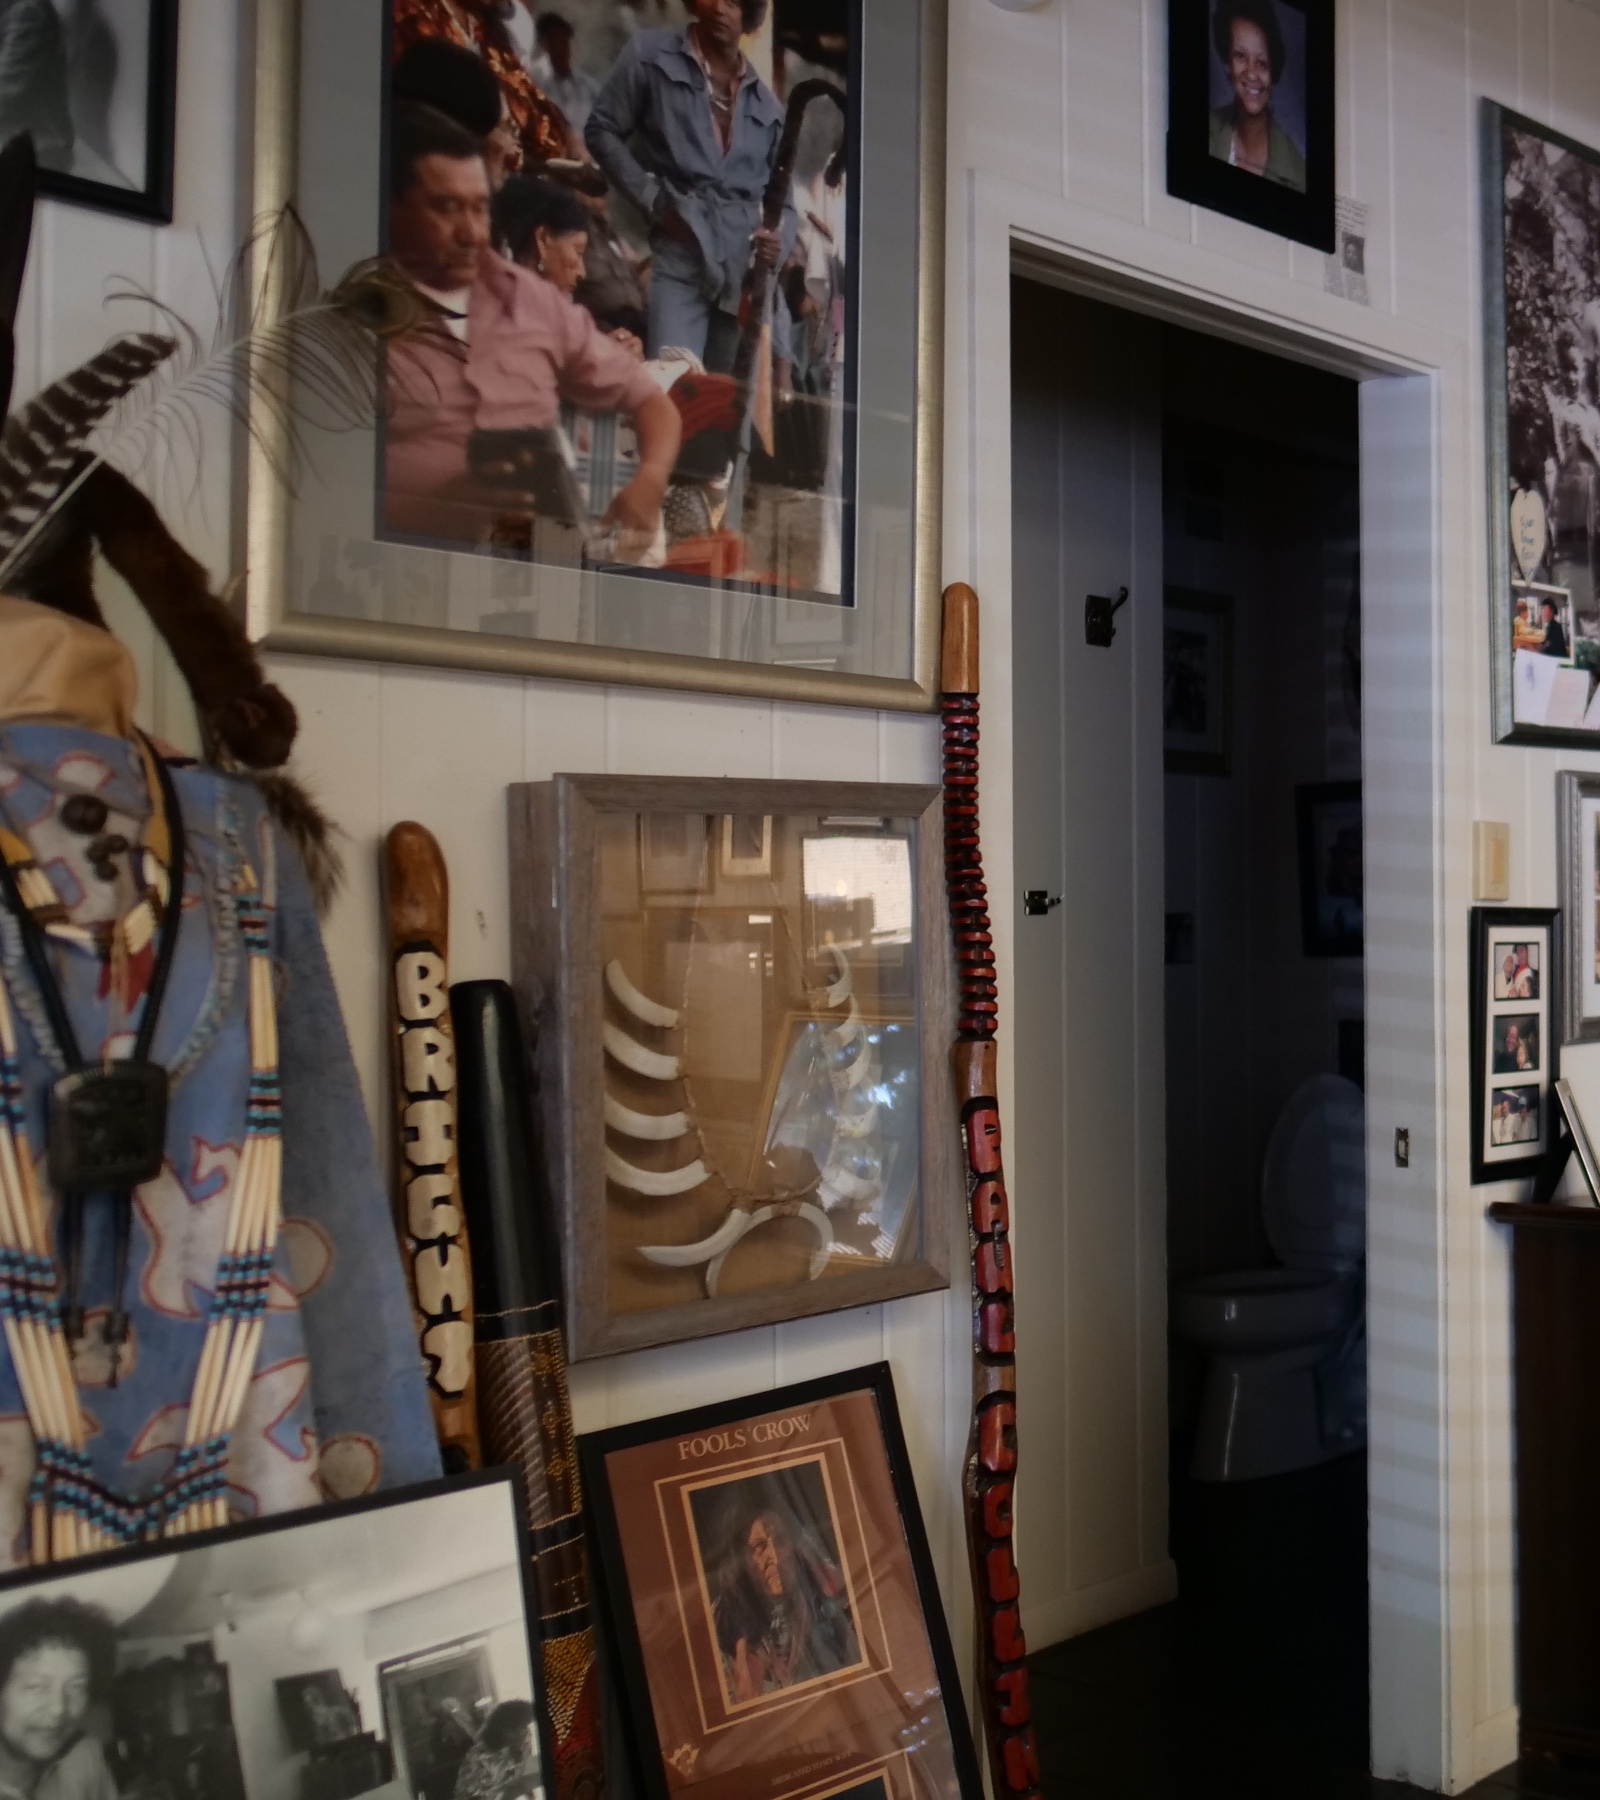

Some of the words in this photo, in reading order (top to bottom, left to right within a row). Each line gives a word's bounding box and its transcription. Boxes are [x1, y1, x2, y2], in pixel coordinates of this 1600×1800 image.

[394, 950, 473, 1394] BRIGHT
[970, 1109, 1016, 1355] PAUL
[678, 1429, 746, 1461] FOOLS
[752, 1413, 812, 1443] CROW
[978, 1402, 1046, 1799] COLLIN
